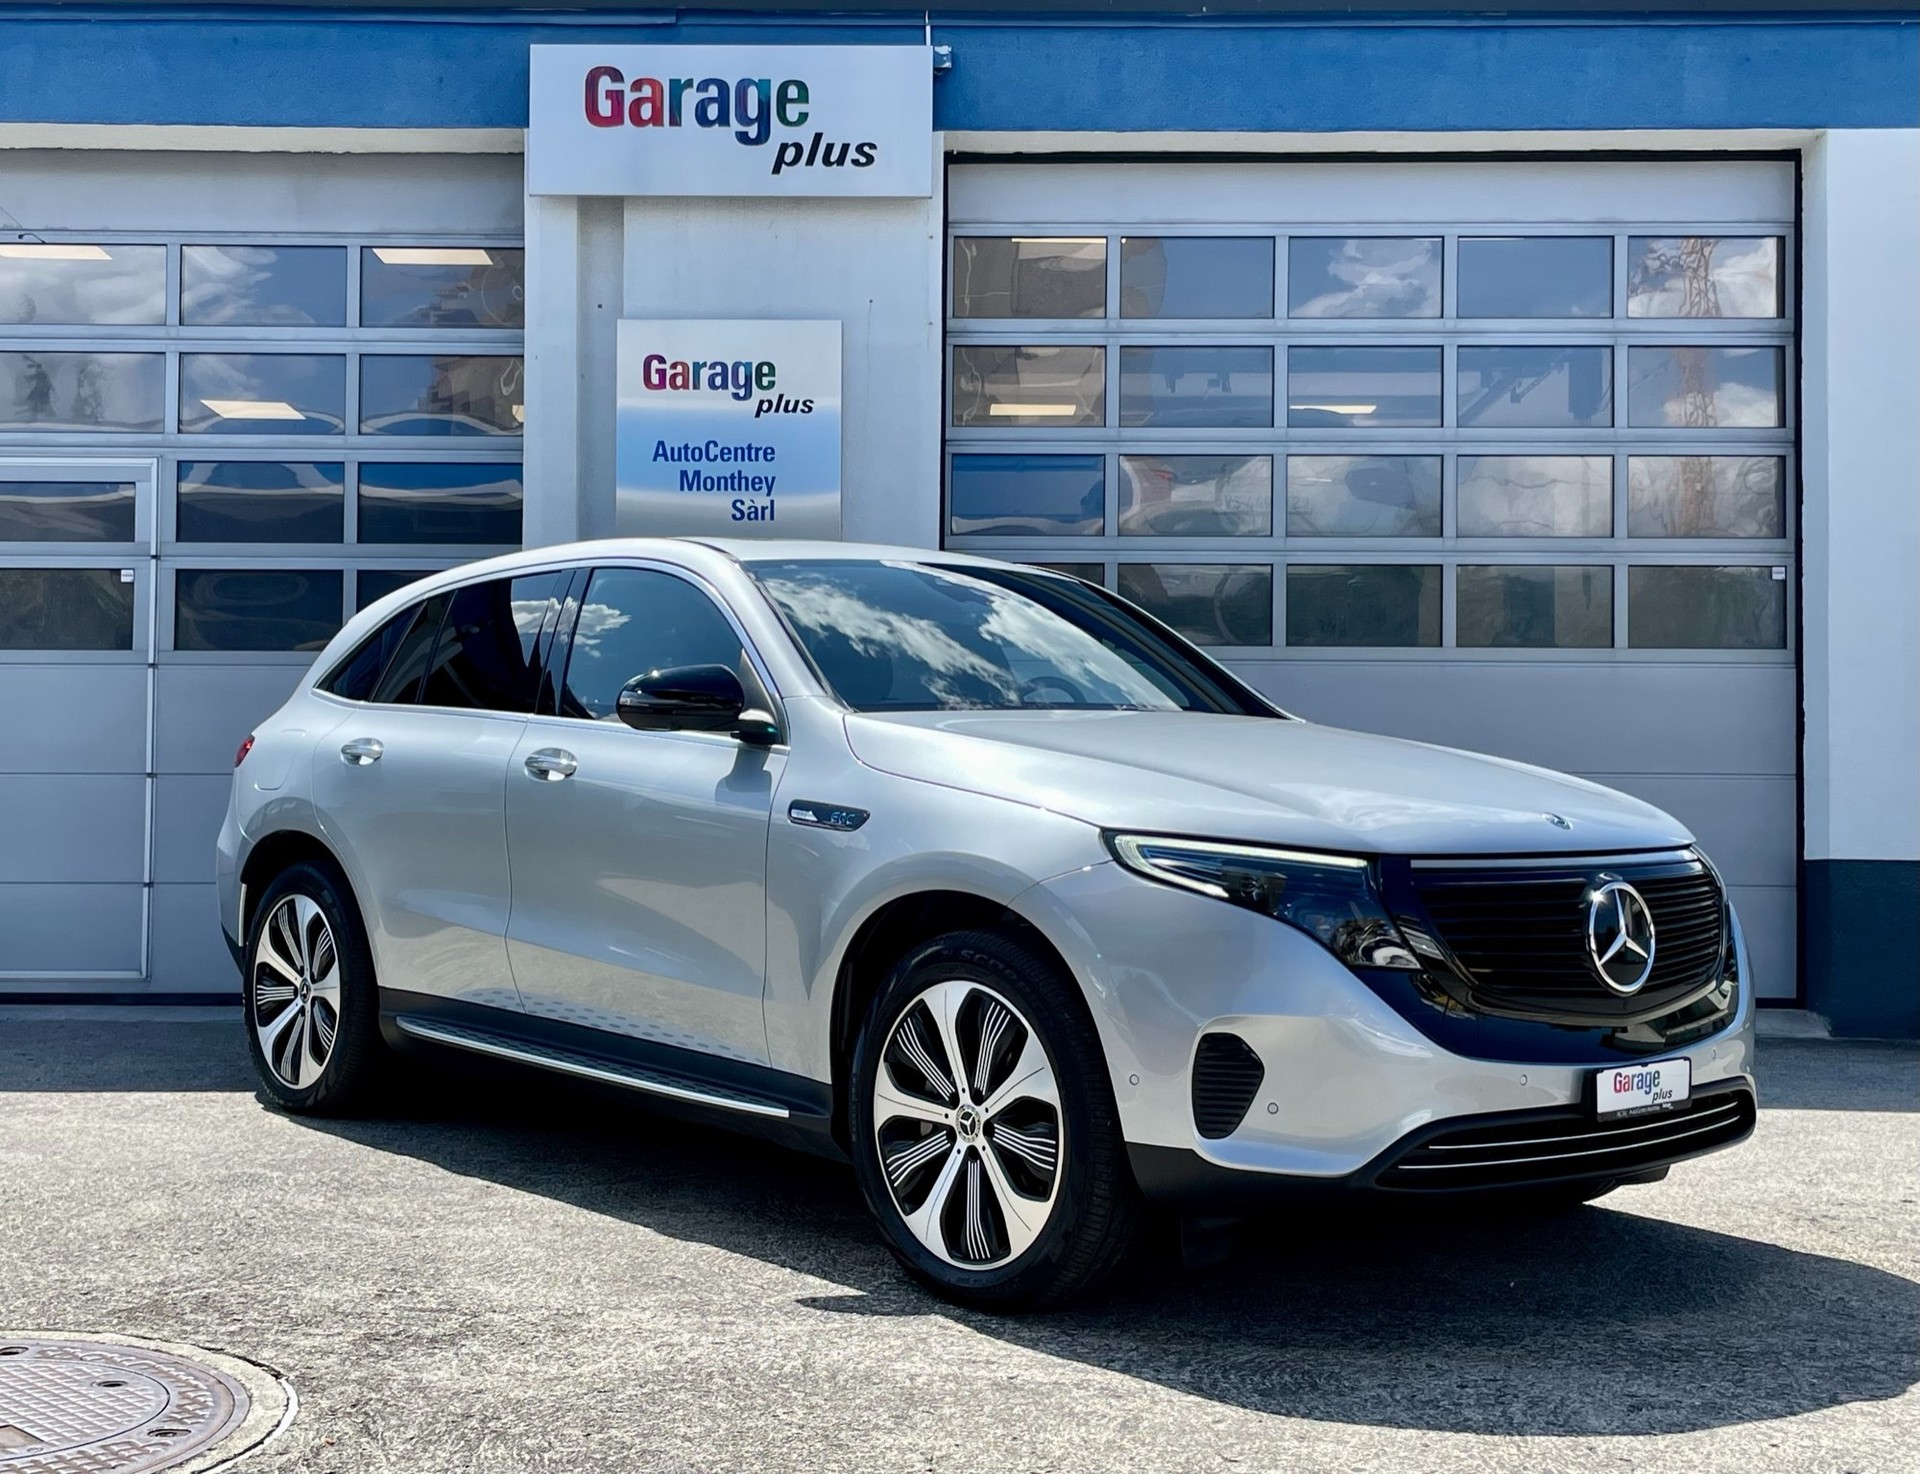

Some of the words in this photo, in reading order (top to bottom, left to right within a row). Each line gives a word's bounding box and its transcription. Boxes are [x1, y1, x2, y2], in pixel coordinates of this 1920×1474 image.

[584, 65, 810, 147] Garage
[771, 132, 878, 175] plus
[642, 354, 776, 401] Garage
[754, 393, 815, 418] plus
[652, 440, 776, 463] AutoCentre
[679, 470, 777, 497] Monthey
[731, 499, 775, 521] Sàrl
[1613, 1070, 1661, 1095] Garage
[1652, 1088, 1673, 1104] plus
